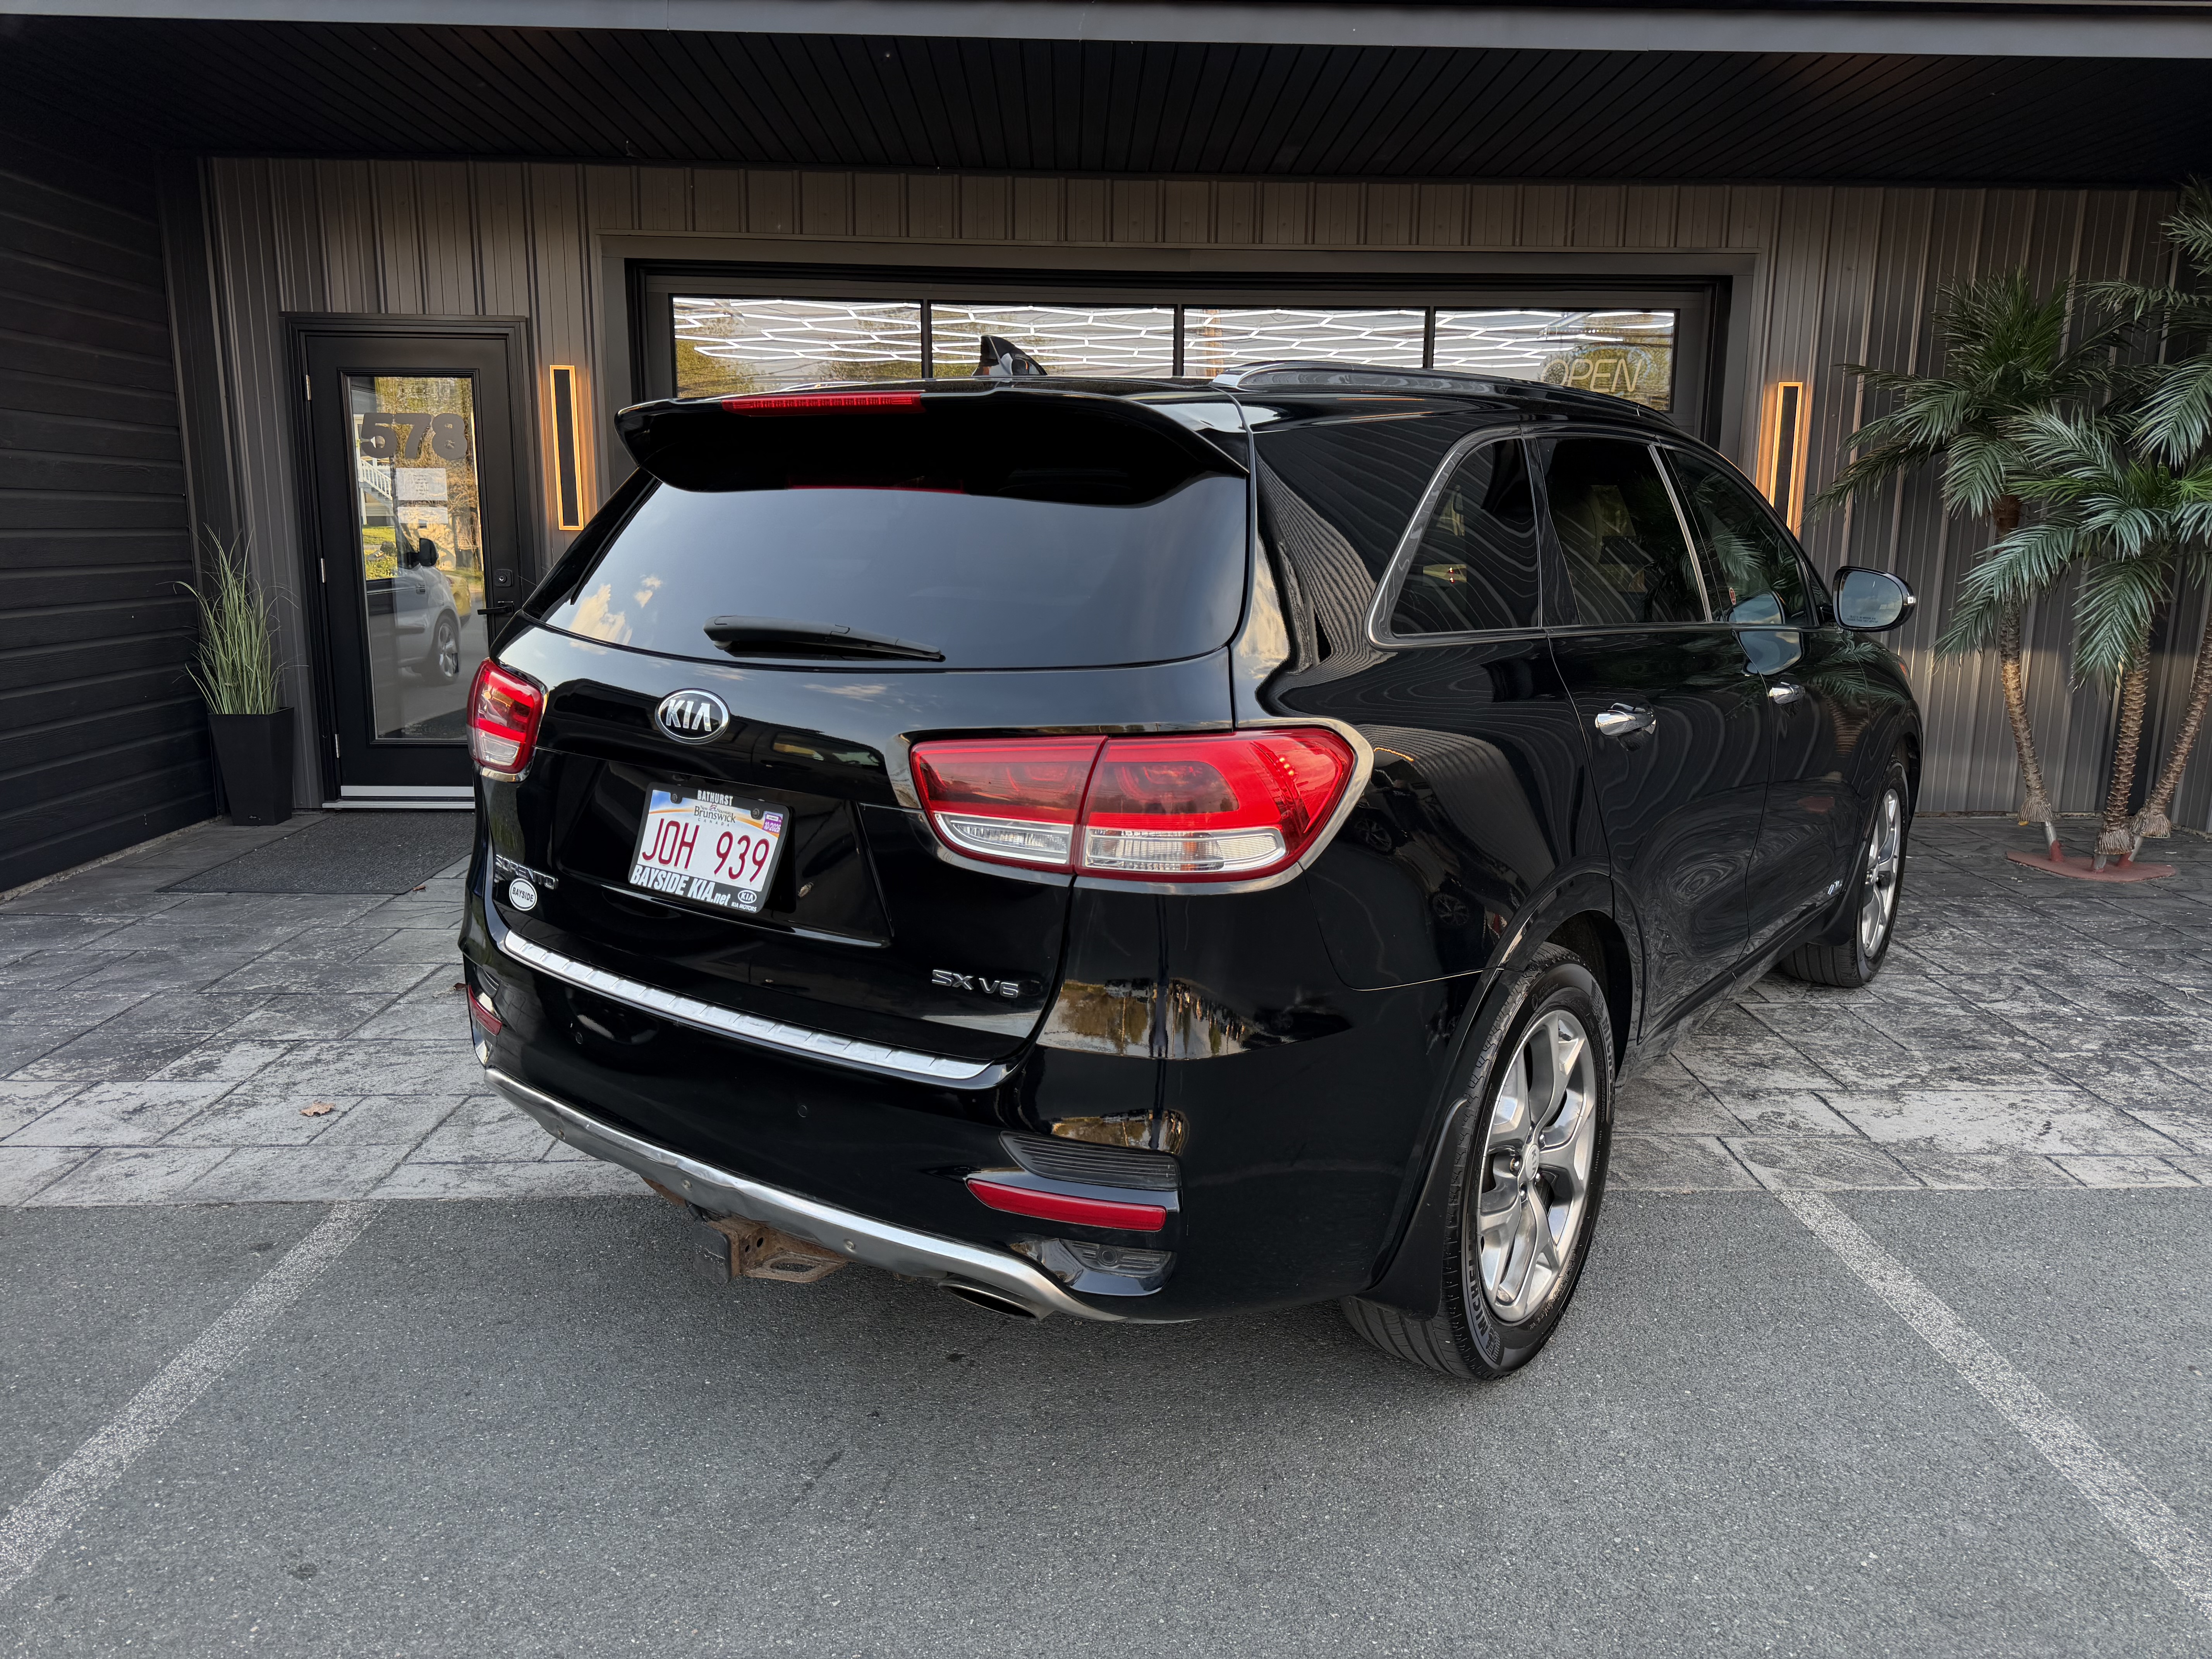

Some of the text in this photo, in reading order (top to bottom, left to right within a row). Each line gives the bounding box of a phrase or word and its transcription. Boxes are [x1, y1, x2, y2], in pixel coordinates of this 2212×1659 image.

[1540, 359, 1642, 392] OPEN
[360, 412, 467, 460] 578
[666, 699, 712, 732] KIA
[697, 790, 733, 806] BATHURST
[694, 805, 736, 823] Brunswick
[698, 817, 729, 827] CANADA
[642, 818, 770, 883] JOH 939
[512, 887, 534, 903] BAYSIDE
[630, 864, 731, 906] BAYSIDE KIA.net
[739, 903, 757, 912] MOTORS
[740, 892, 754, 902] KIA
[932, 969, 1019, 998] SX V6
